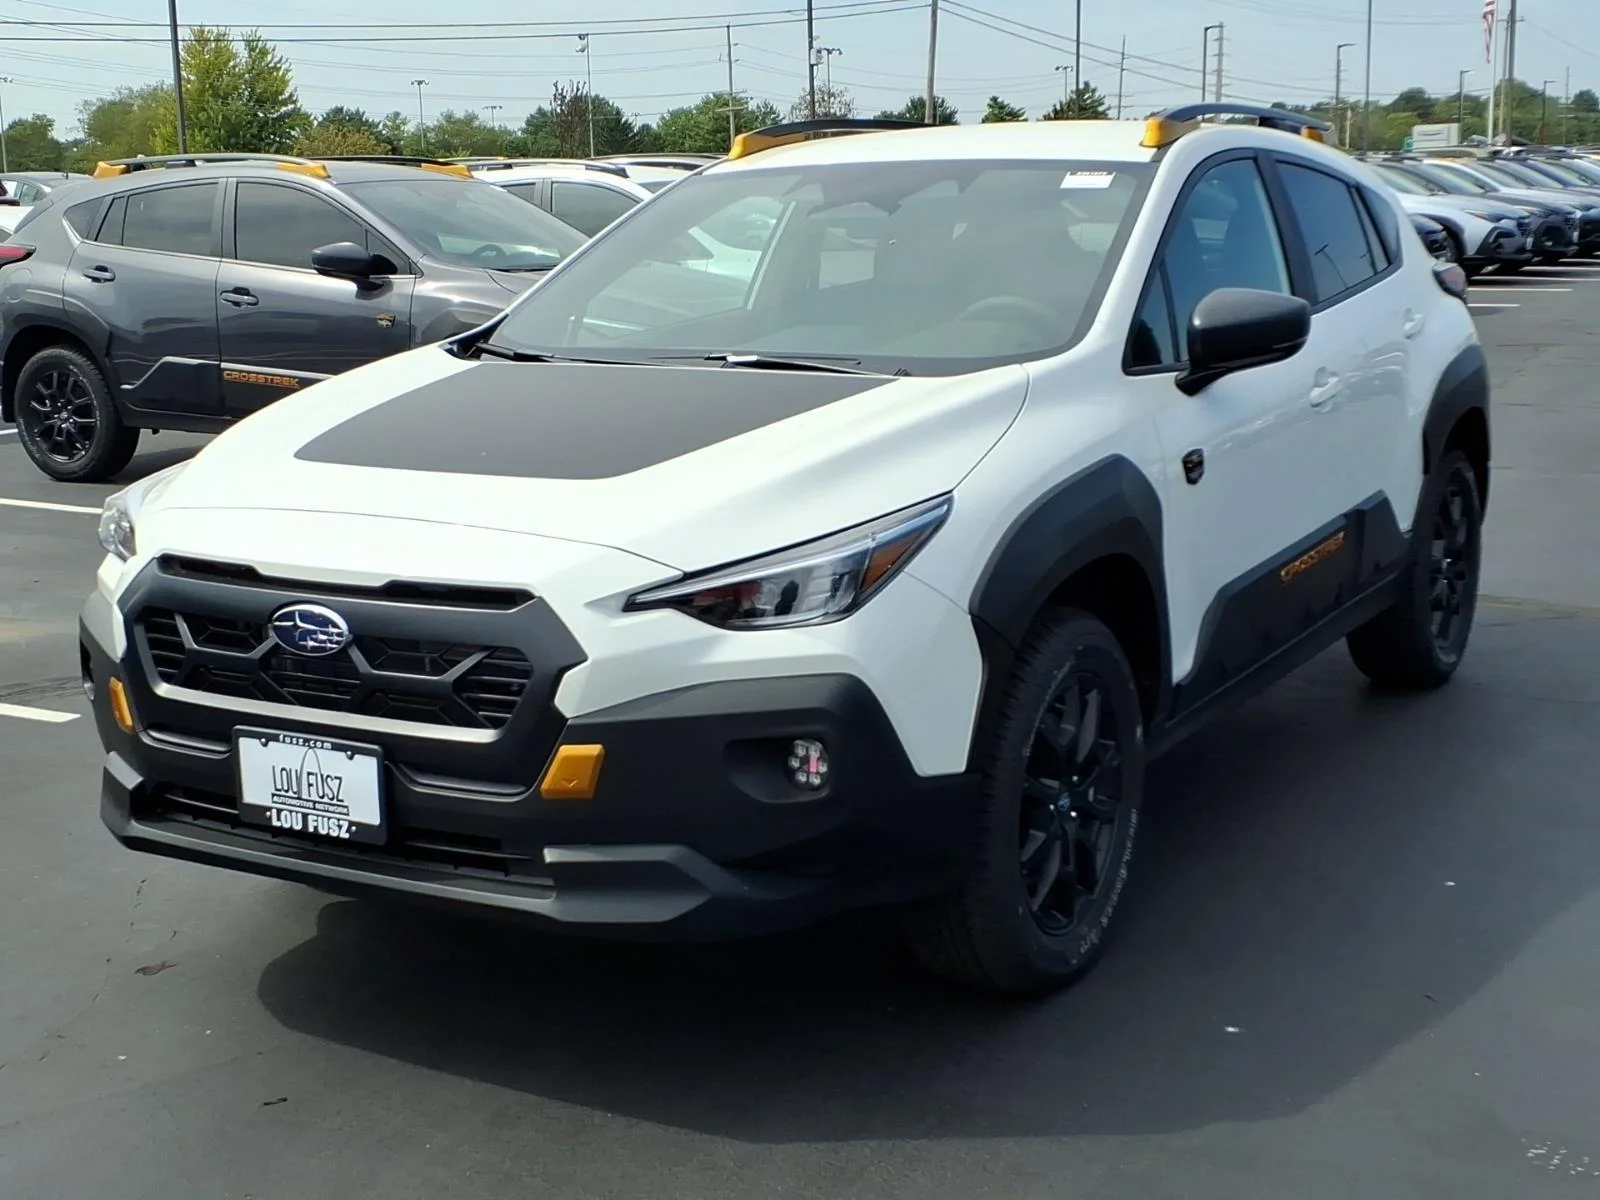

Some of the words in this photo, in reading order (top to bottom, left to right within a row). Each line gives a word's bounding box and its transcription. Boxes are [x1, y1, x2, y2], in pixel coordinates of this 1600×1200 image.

[223, 370, 300, 387] CROSSTREK
[278, 734, 332, 749] fusz.com
[272, 765, 299, 796] LOU
[306, 771, 344, 803] FUSZ
[272, 795, 315, 809] AUTOMOTIVE
[271, 808, 302, 831] LOU
[307, 815, 350, 839] FUSZ
